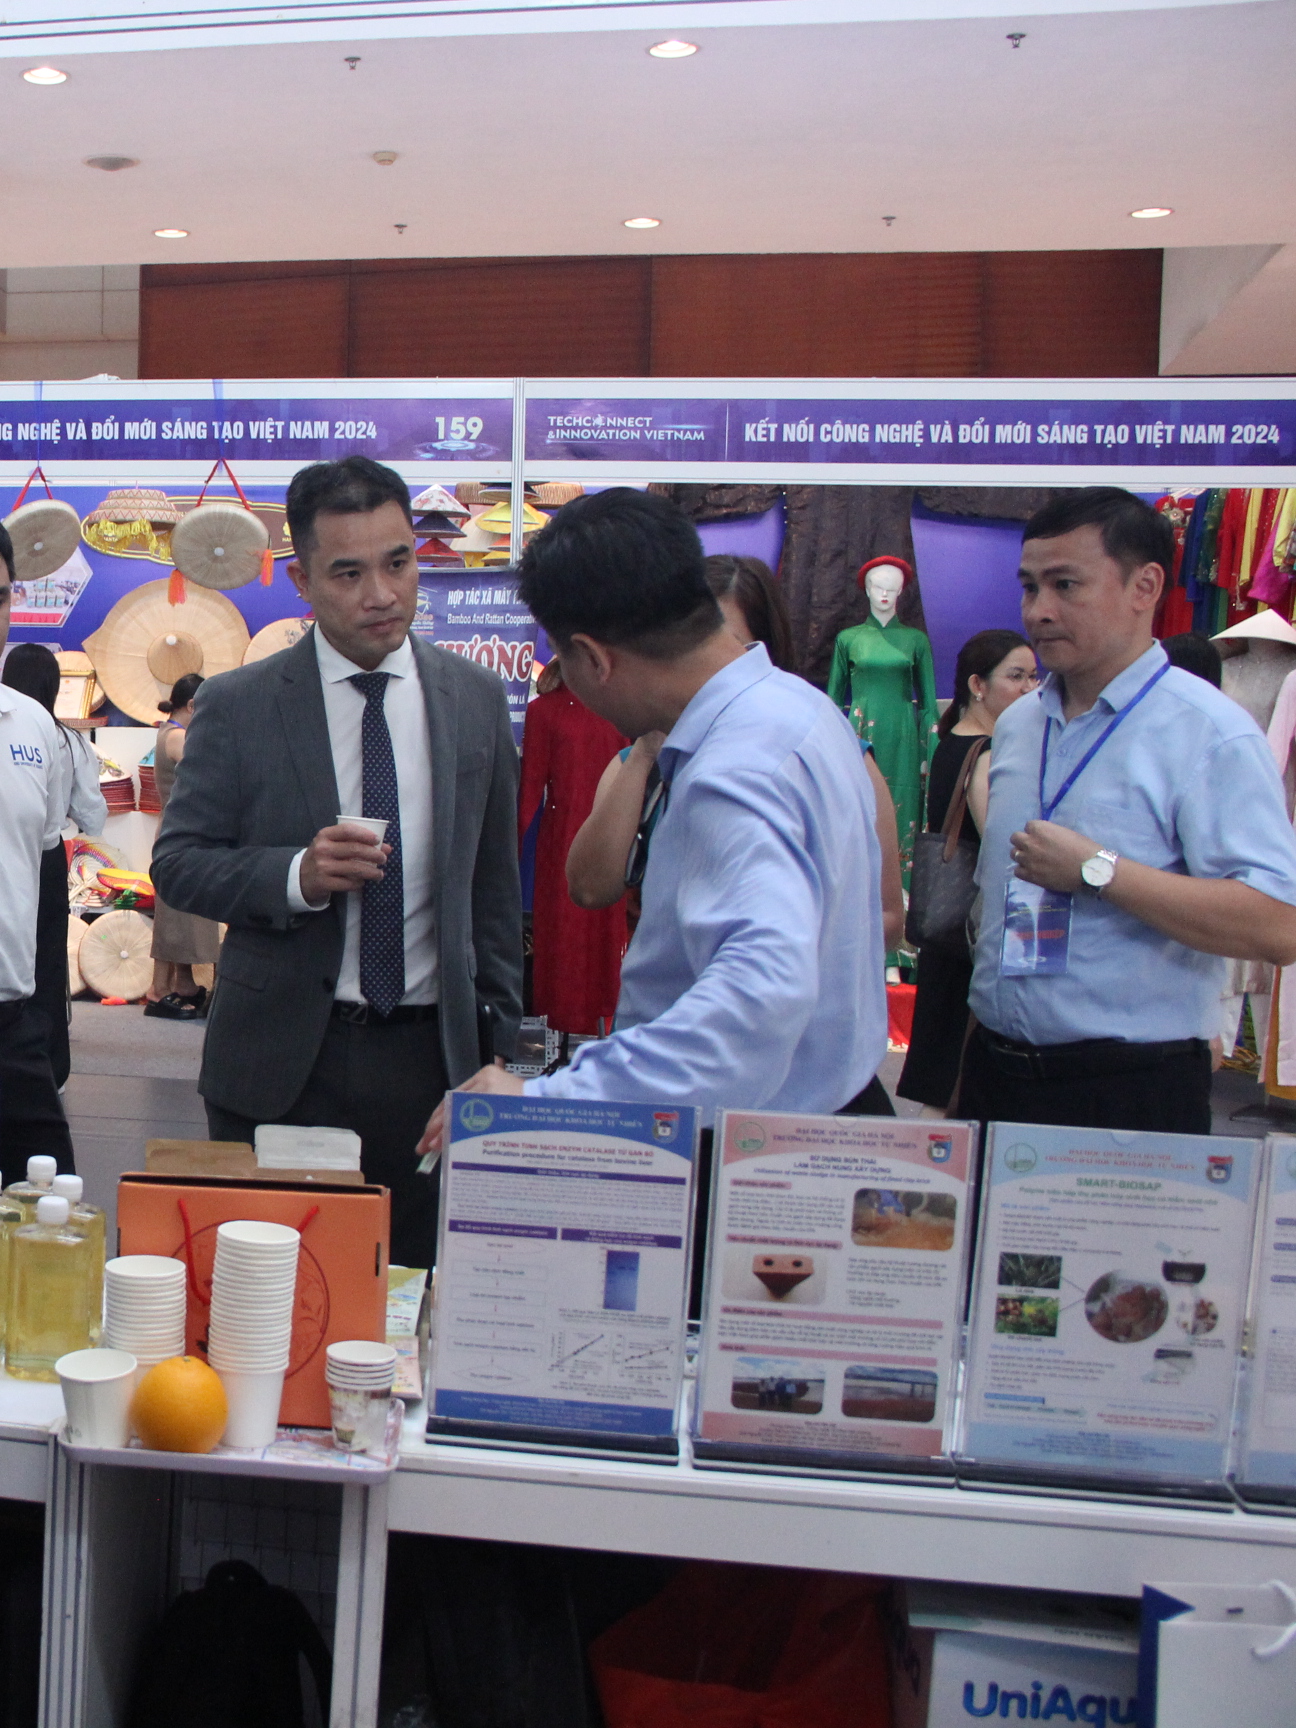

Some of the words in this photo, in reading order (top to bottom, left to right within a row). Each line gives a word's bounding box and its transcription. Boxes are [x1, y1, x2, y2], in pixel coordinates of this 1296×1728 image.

[18, 418, 61, 445] NGHỆ
[66, 418, 87, 441] VÀ
[91, 415, 119, 441] ĐỔI
[124, 417, 157, 440] MỚI
[161, 417, 207, 440] SÁNG
[213, 421, 244, 444] TẠO
[249, 416, 285, 444] VIỆT
[289, 421, 330, 440] NAM
[334, 421, 377, 440] 2024
[434, 416, 484, 440] 159
[644, 429, 705, 441] VIETNAM
[744, 418, 778, 442] KẾT
[782, 416, 814, 443] NỐI
[819, 419, 869, 443] CÔNG
[875, 419, 924, 447] NGHỆ
[930, 419, 954, 444] VÀ
[958, 416, 989, 444] ĐỔI
[995, 420, 1031, 445] MỚI
[1036, 420, 1088, 445] SÁNG
[1094, 424, 1129, 448] TẠO
[1135, 419, 1175, 448] VIỆT
[1180, 424, 1226, 445] NAM
[1230, 424, 1280, 445] 2024
[448, 588, 464, 609] HỢP
[465, 587, 480, 606] TÁC
[447, 613, 472, 625] Bamboo
[472, 613, 485, 625] And
[485, 613, 504, 625] Rattan
[9, 744, 43, 764] HUS
[1076, 1177, 1162, 1191] SMART-BIOSAP
